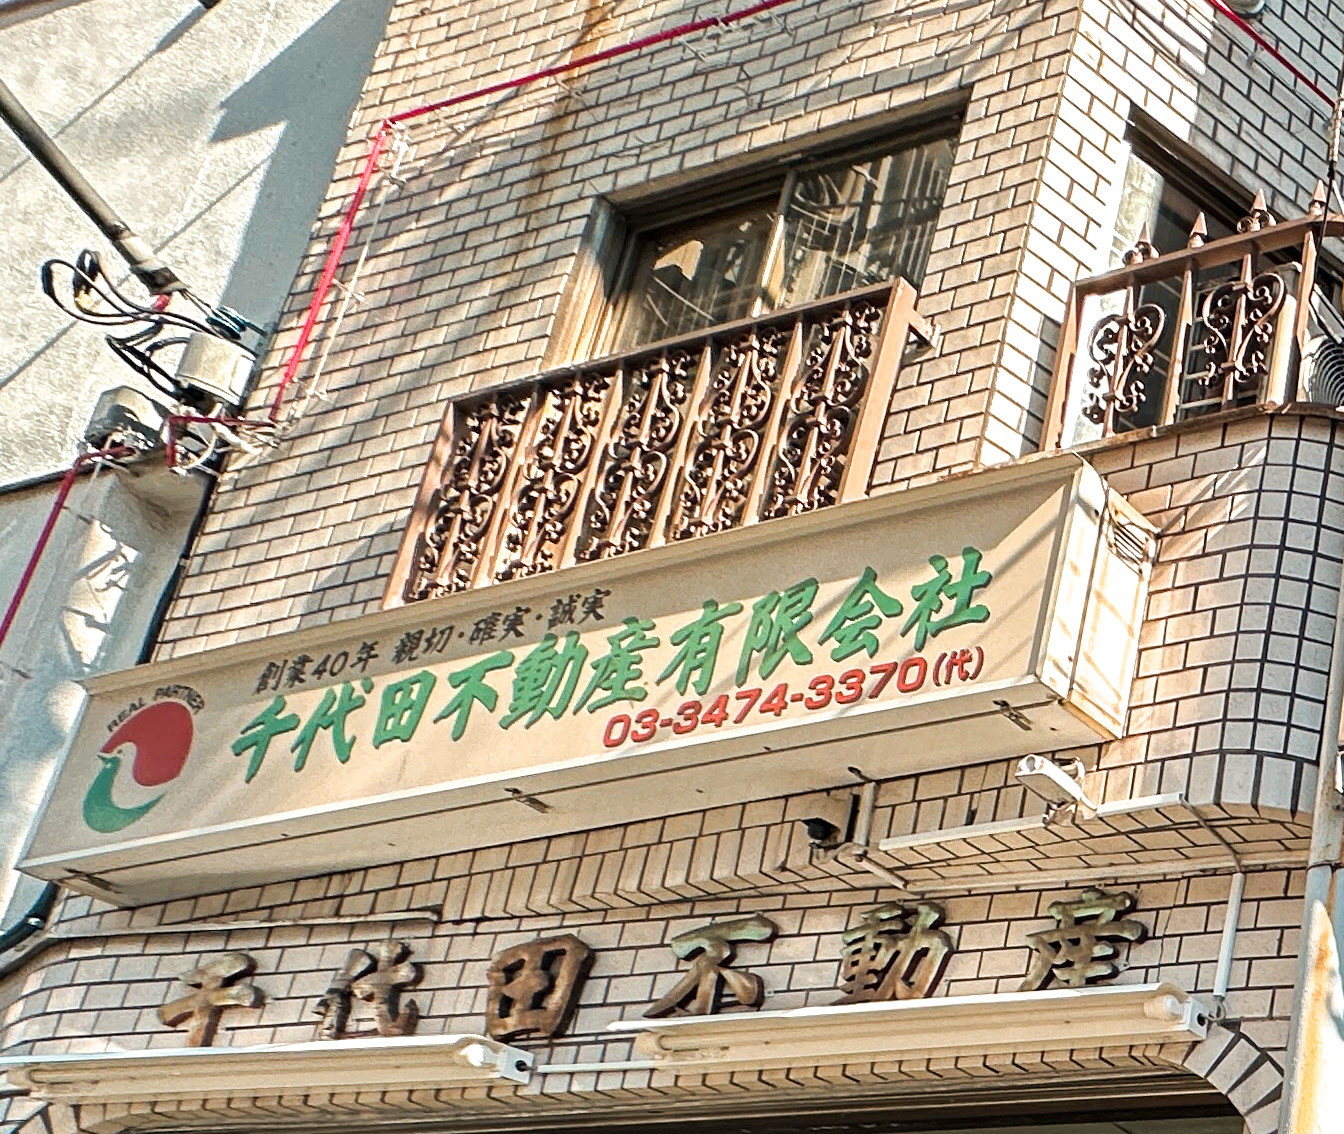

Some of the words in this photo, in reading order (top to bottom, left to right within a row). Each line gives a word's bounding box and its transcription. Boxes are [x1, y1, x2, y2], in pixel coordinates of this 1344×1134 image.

[231, 546, 994, 786] 千代田不動産有限会社
[253, 640, 380, 695] 創業40年
[390, 588, 613, 666] 親切・確実・誠実
[602, 645, 985, 749] 03-3474-3370(代)
[157, 885, 1148, 1047] 千代田不動産
